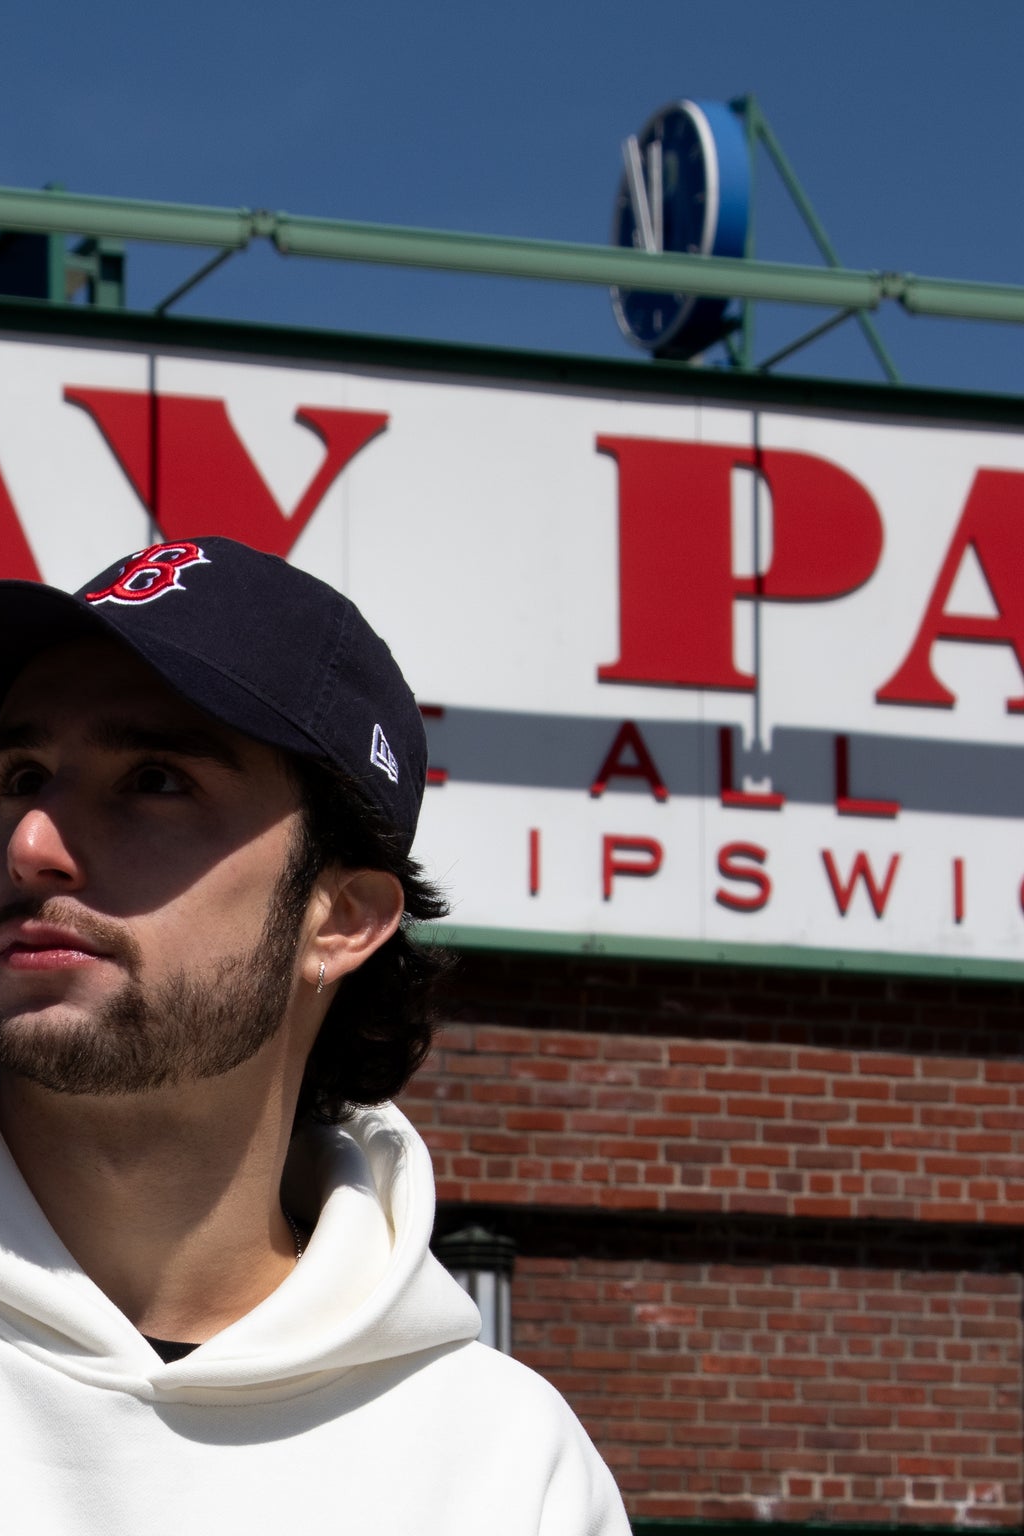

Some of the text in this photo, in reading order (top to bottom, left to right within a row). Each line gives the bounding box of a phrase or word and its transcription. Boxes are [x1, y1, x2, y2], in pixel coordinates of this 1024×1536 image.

[85, 542, 212, 606] B
[590, 720, 901, 817] ALL
[528, 827, 1024, 923] IPSWI
